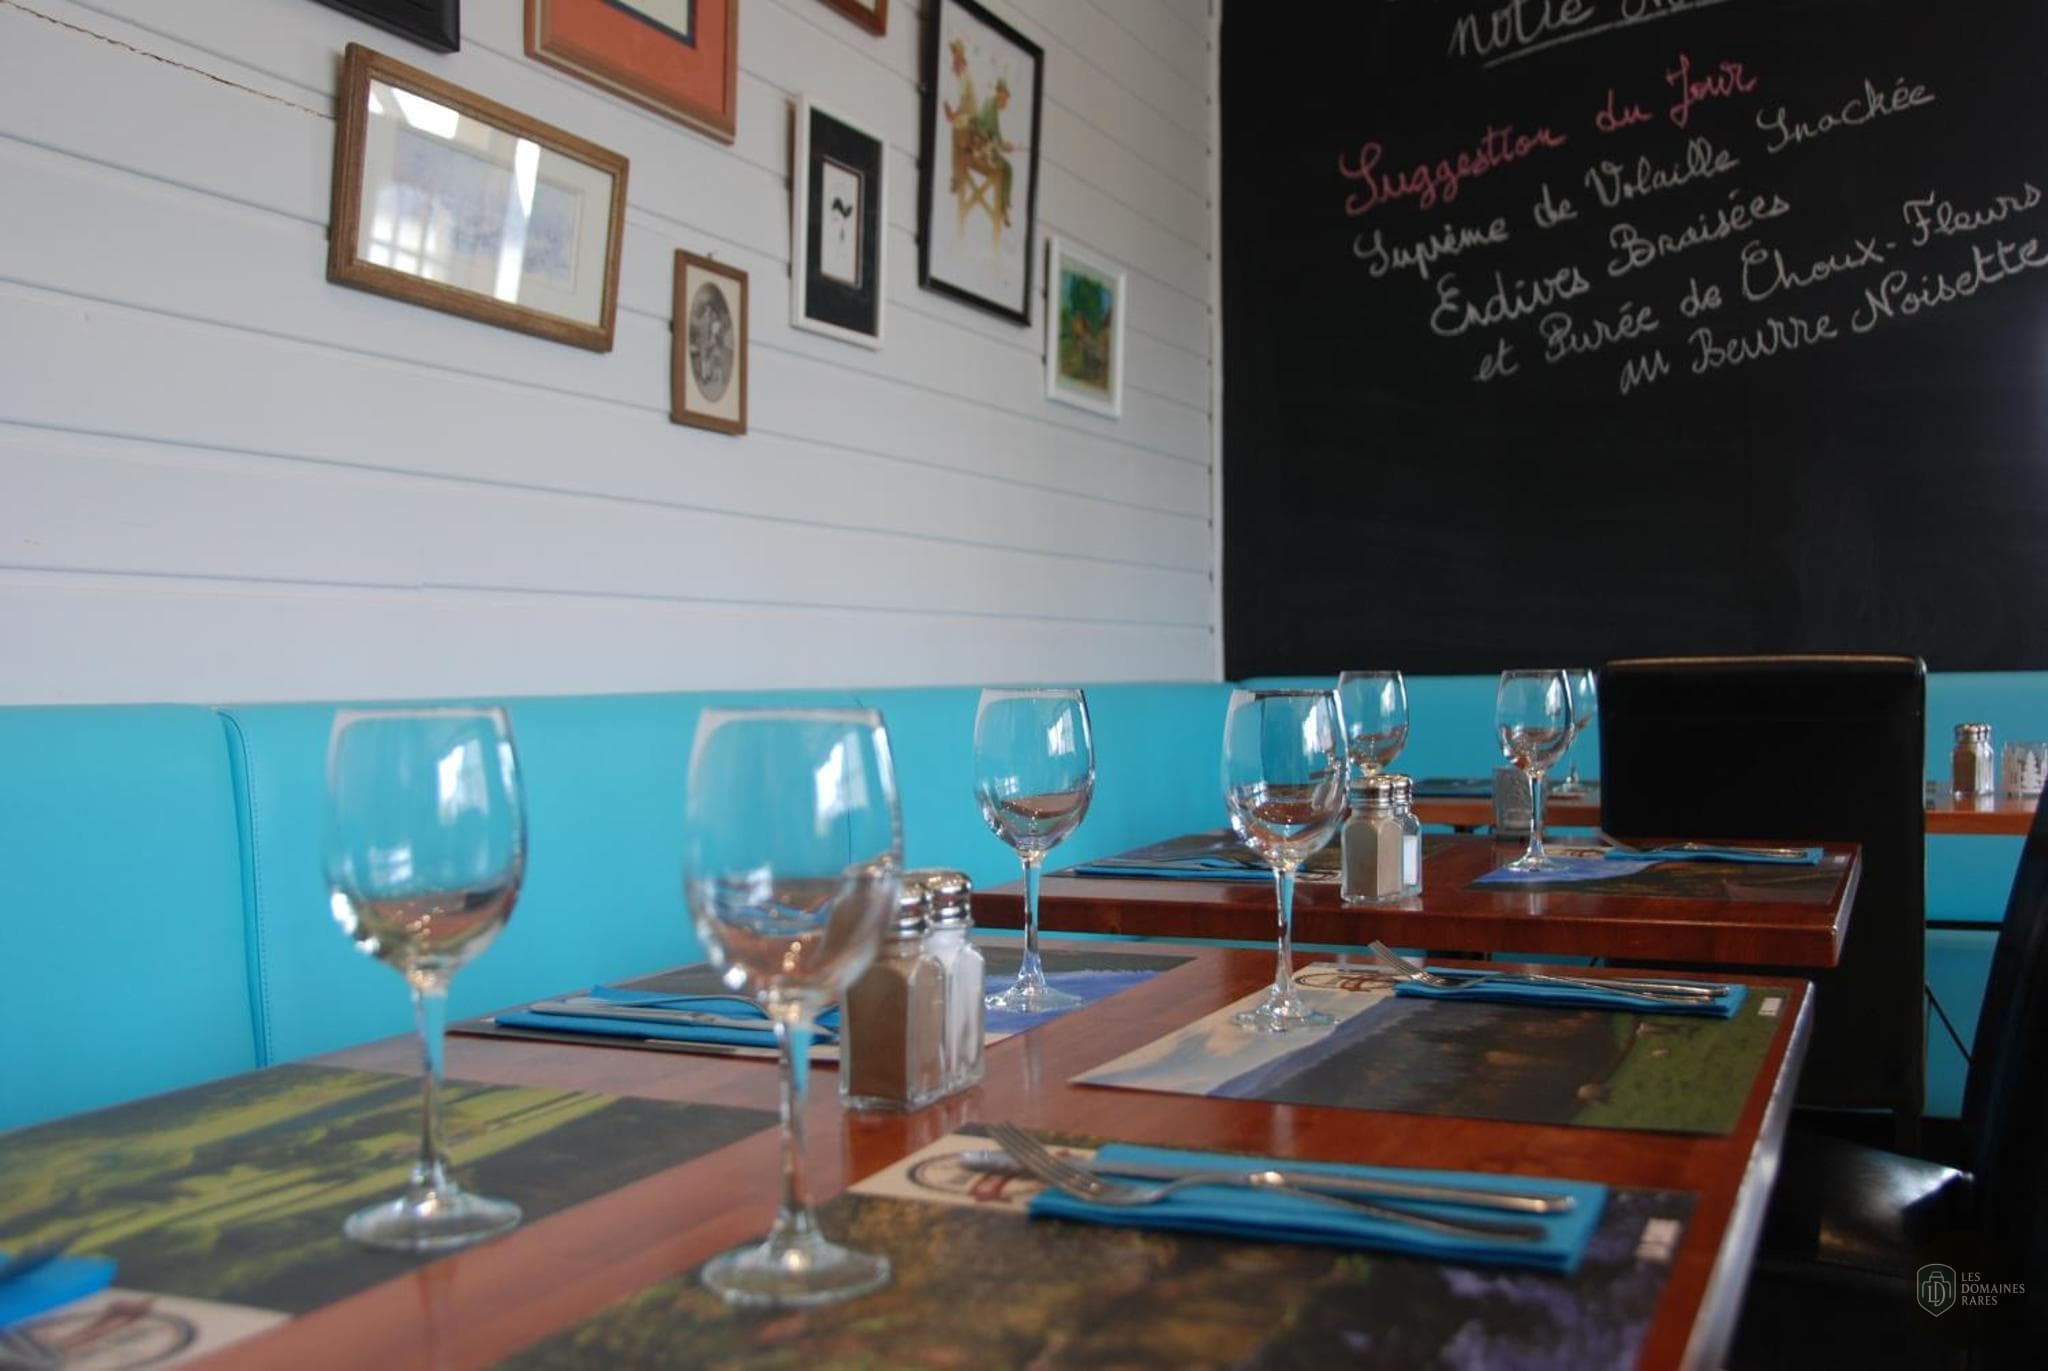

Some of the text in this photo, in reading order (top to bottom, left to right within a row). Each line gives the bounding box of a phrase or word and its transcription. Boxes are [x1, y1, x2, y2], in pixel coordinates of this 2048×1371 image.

[1339, 53, 1758, 217] Suggestion du Jour
[1534, 182, 1579, 229] de
[1584, 136, 1741, 207] Volaille
[1430, 188, 1791, 336] Endives Braisées
[1473, 337, 1519, 382] et
[1538, 301, 1660, 364] Purée
[1679, 277, 1723, 318] de
[1618, 237, 2048, 396] au Beurre Noisette
